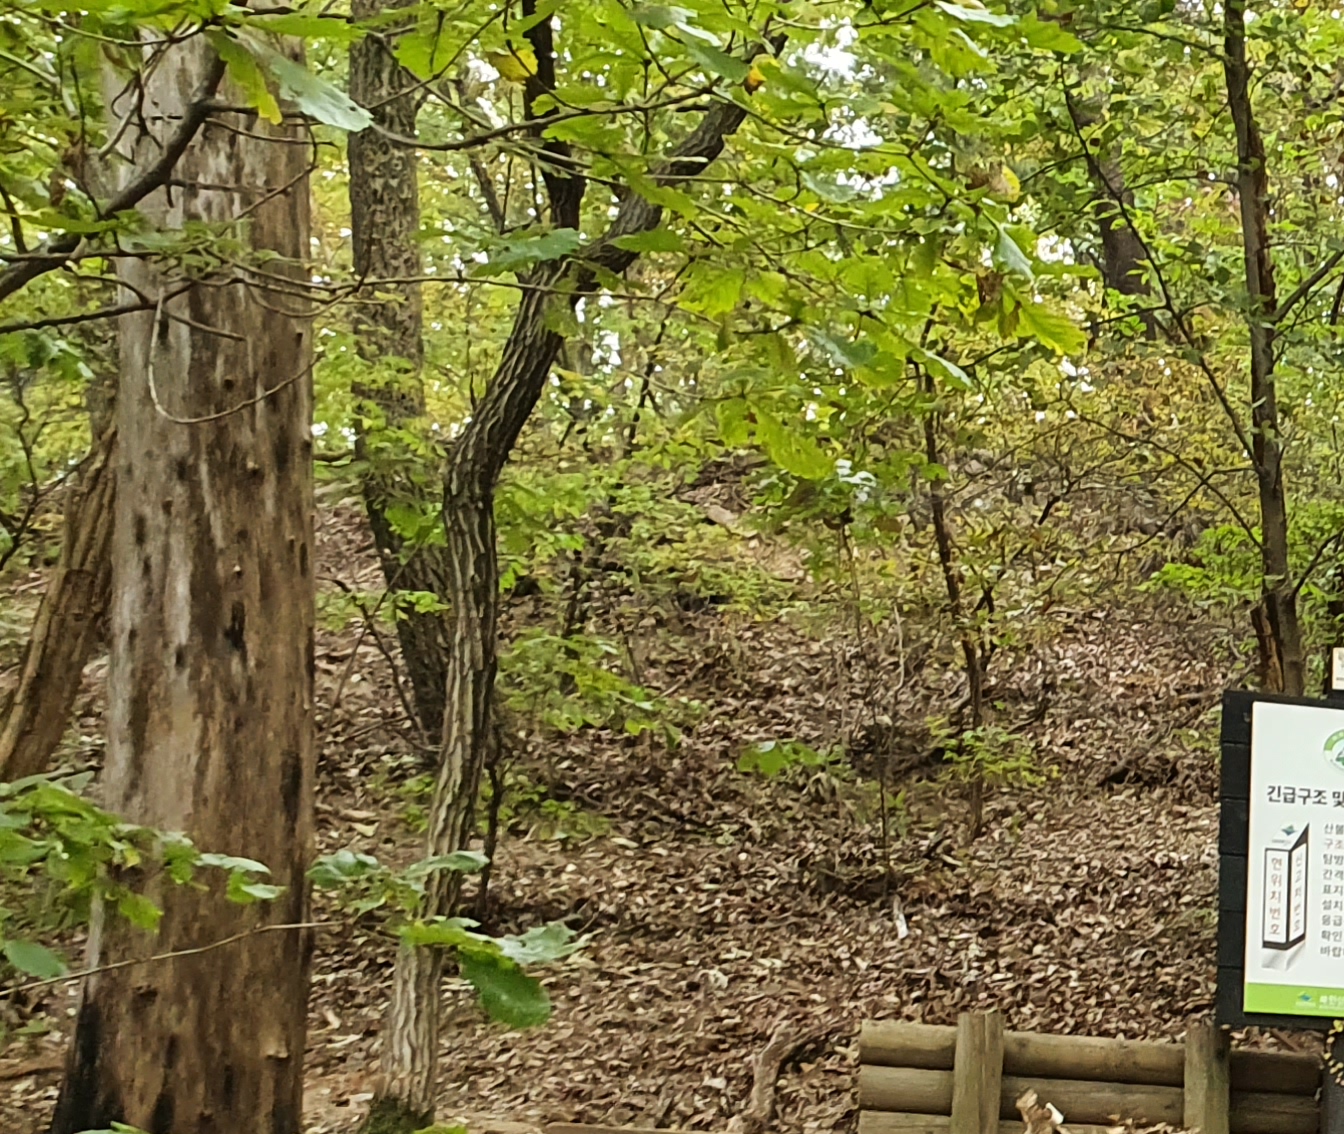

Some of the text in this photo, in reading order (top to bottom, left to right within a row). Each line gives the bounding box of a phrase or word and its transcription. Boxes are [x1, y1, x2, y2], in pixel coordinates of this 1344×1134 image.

[1267, 785, 1328, 805] 긴급구조
[1269, 857, 1282, 935] 현위치번호
[1321, 930, 1342, 942] 확인
